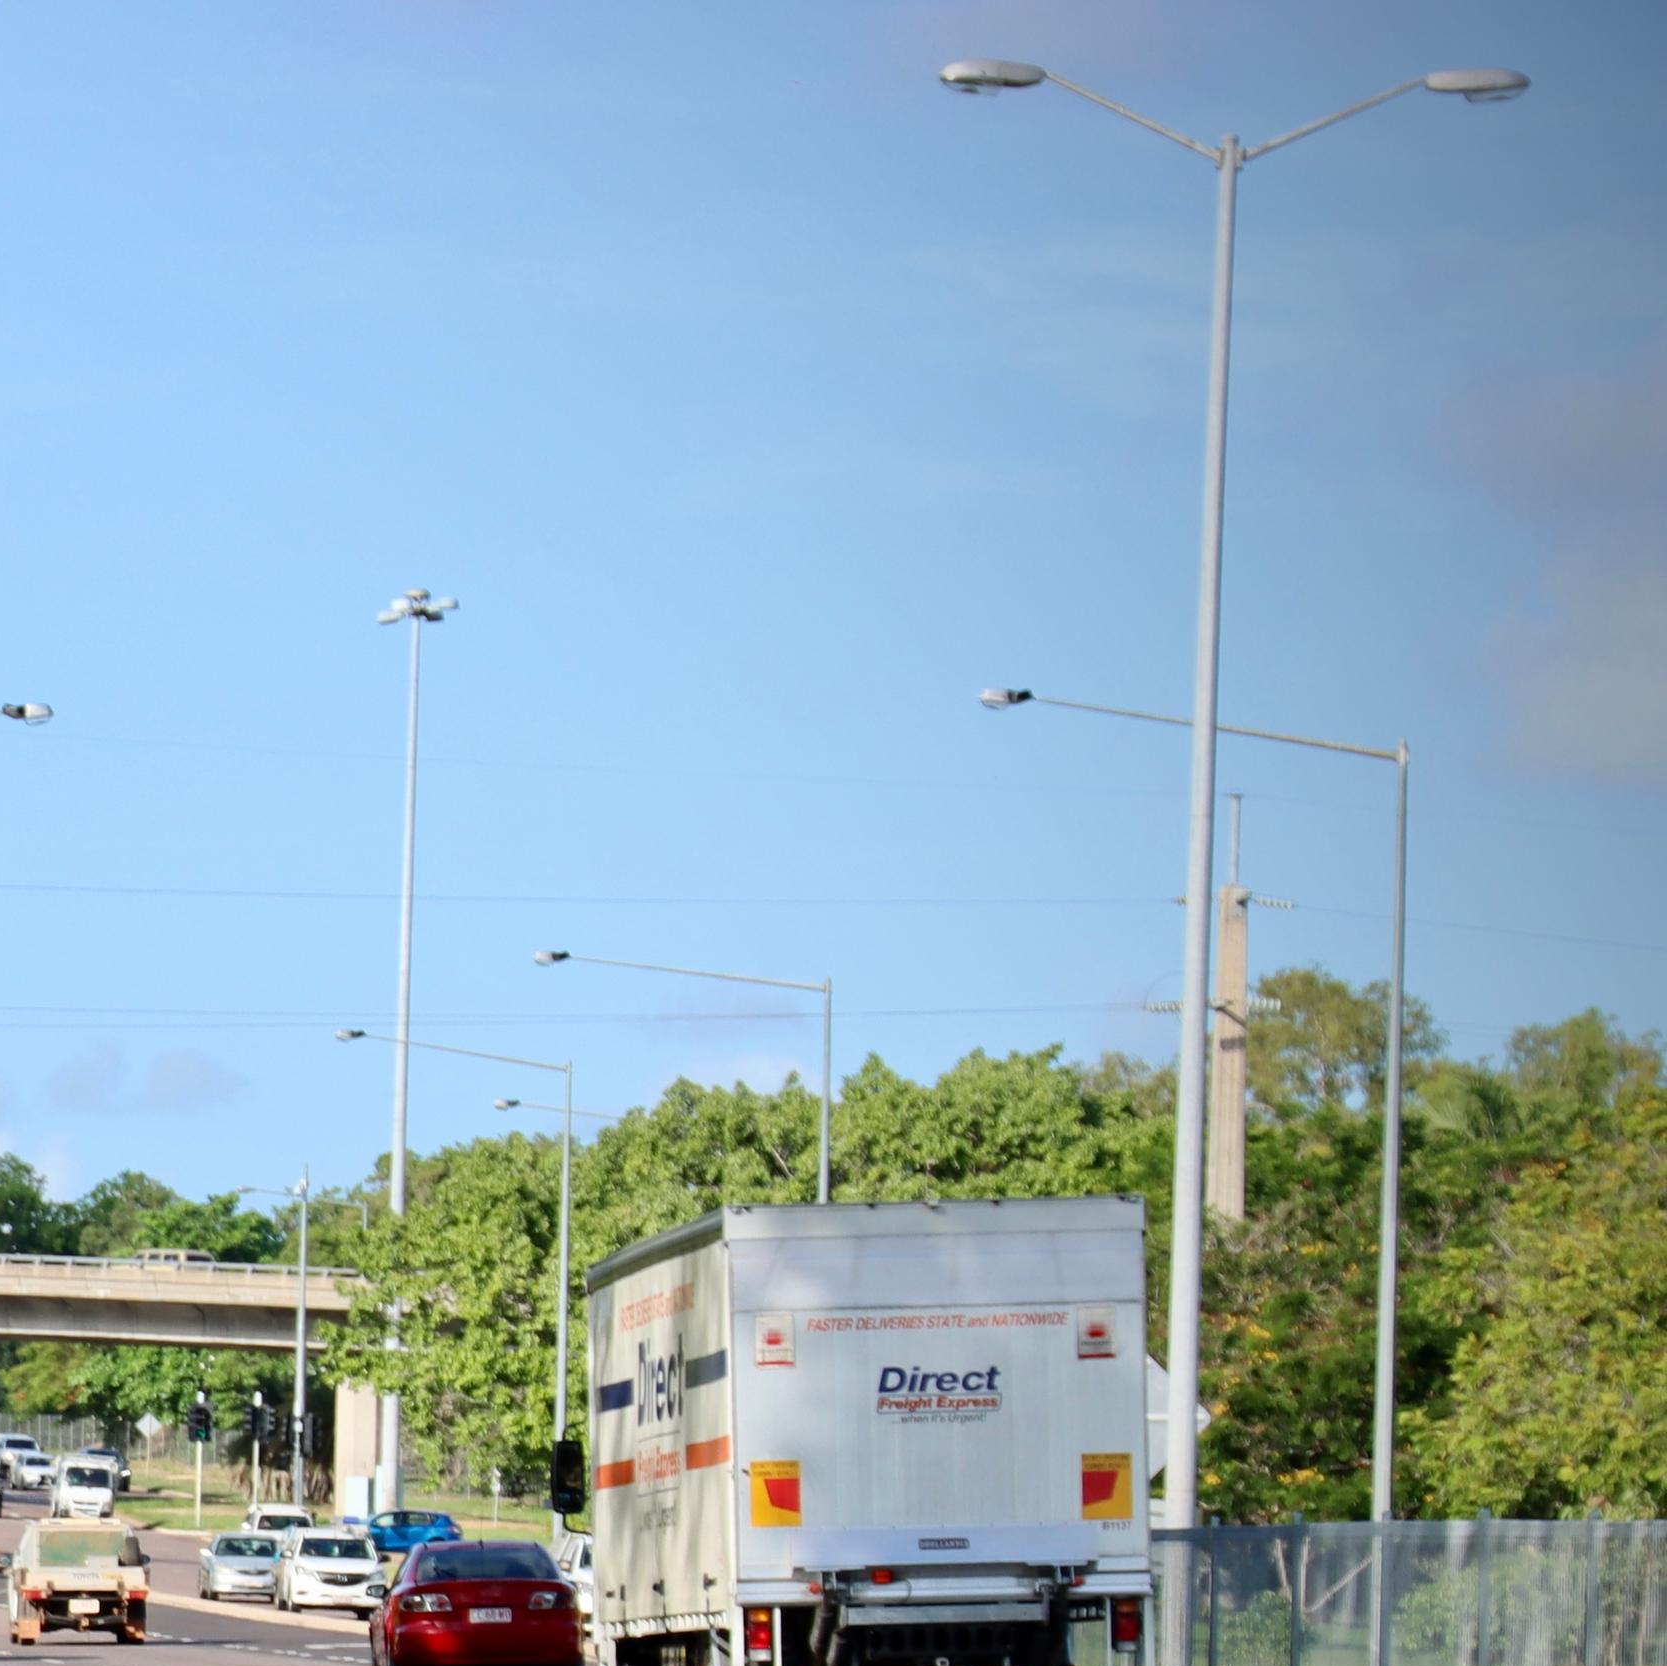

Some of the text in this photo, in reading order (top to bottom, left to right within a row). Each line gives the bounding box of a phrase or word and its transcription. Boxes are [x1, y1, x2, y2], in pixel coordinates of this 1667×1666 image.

[807, 1311, 1068, 1332] FASTER DELIVERIES STATE and NATIONWIDE
[638, 1333, 684, 1428] Direct
[878, 1365, 1001, 1393] Direct
[878, 1395, 999, 1412] Freight Express
